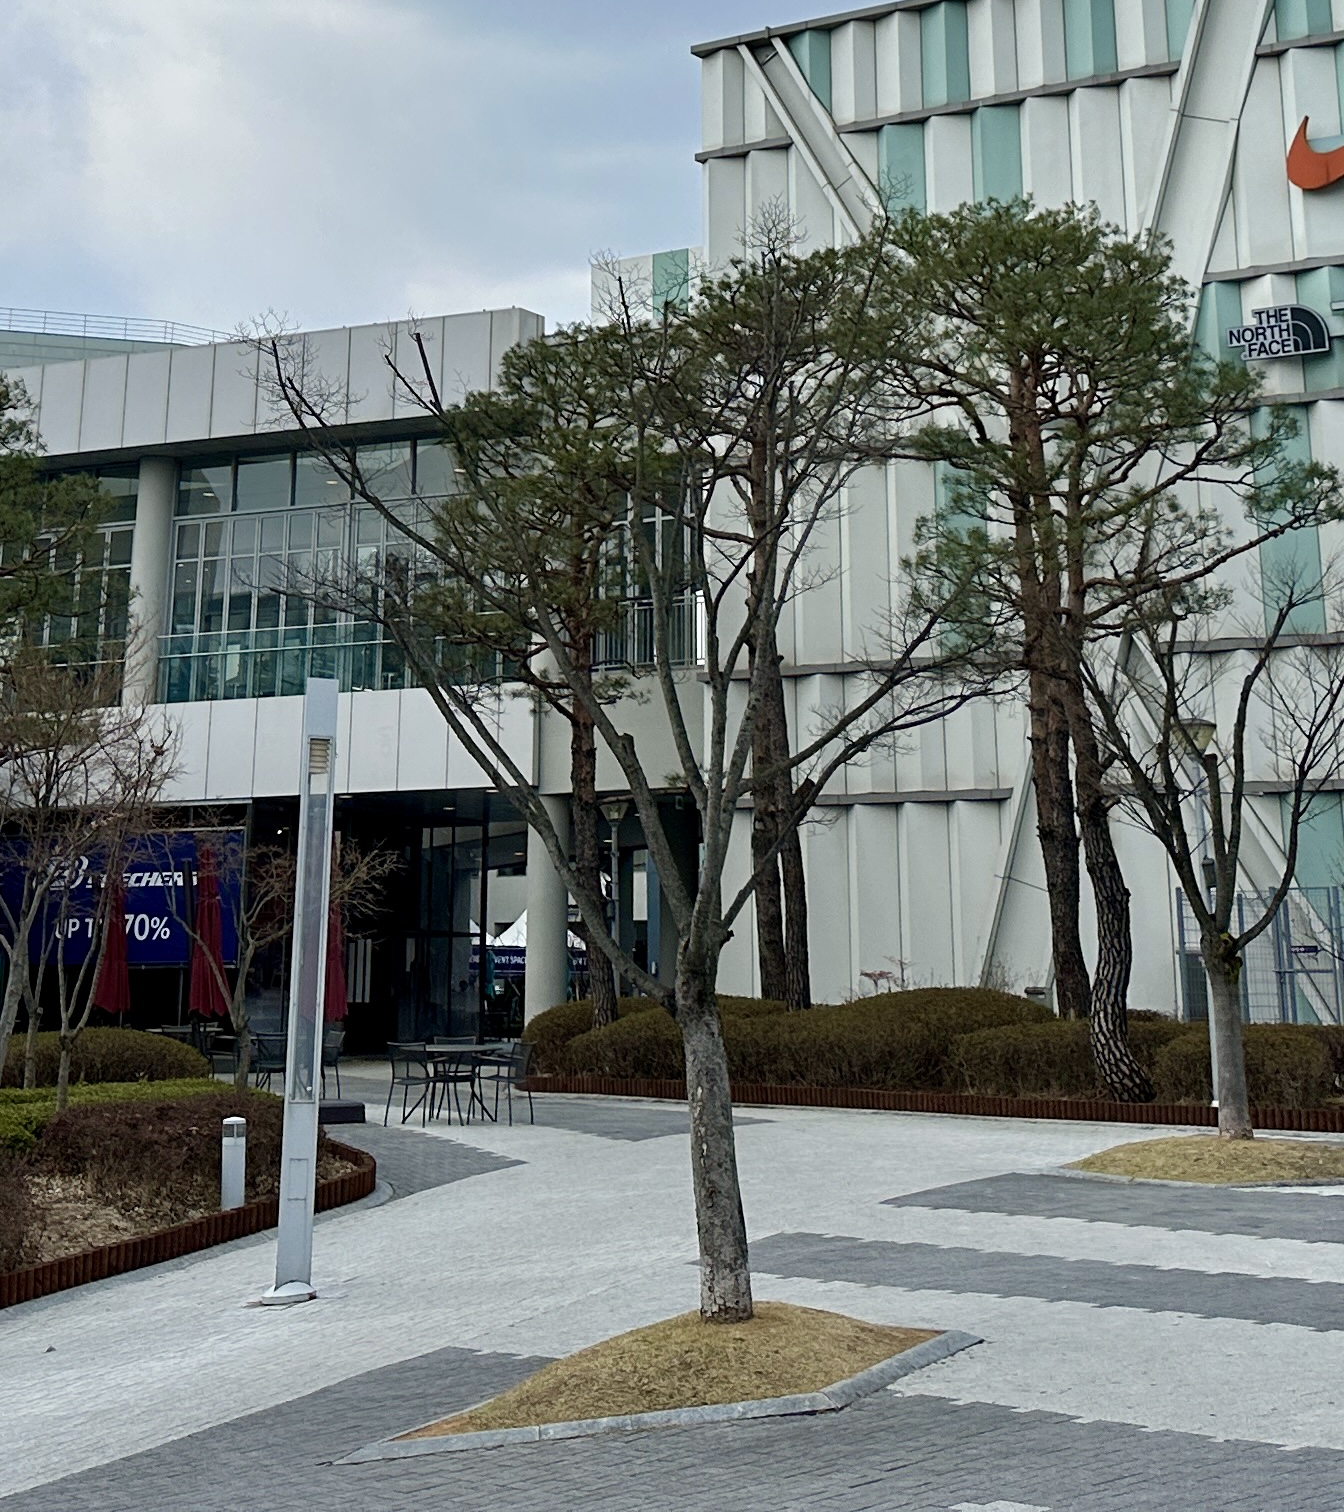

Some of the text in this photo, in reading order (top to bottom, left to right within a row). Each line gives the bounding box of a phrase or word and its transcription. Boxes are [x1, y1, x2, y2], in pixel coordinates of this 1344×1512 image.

[1255, 307, 1290, 325] THE
[1228, 322, 1291, 346] NORTH
[1247, 337, 1293, 358] FACE
[124, 914, 170, 941] 70%
